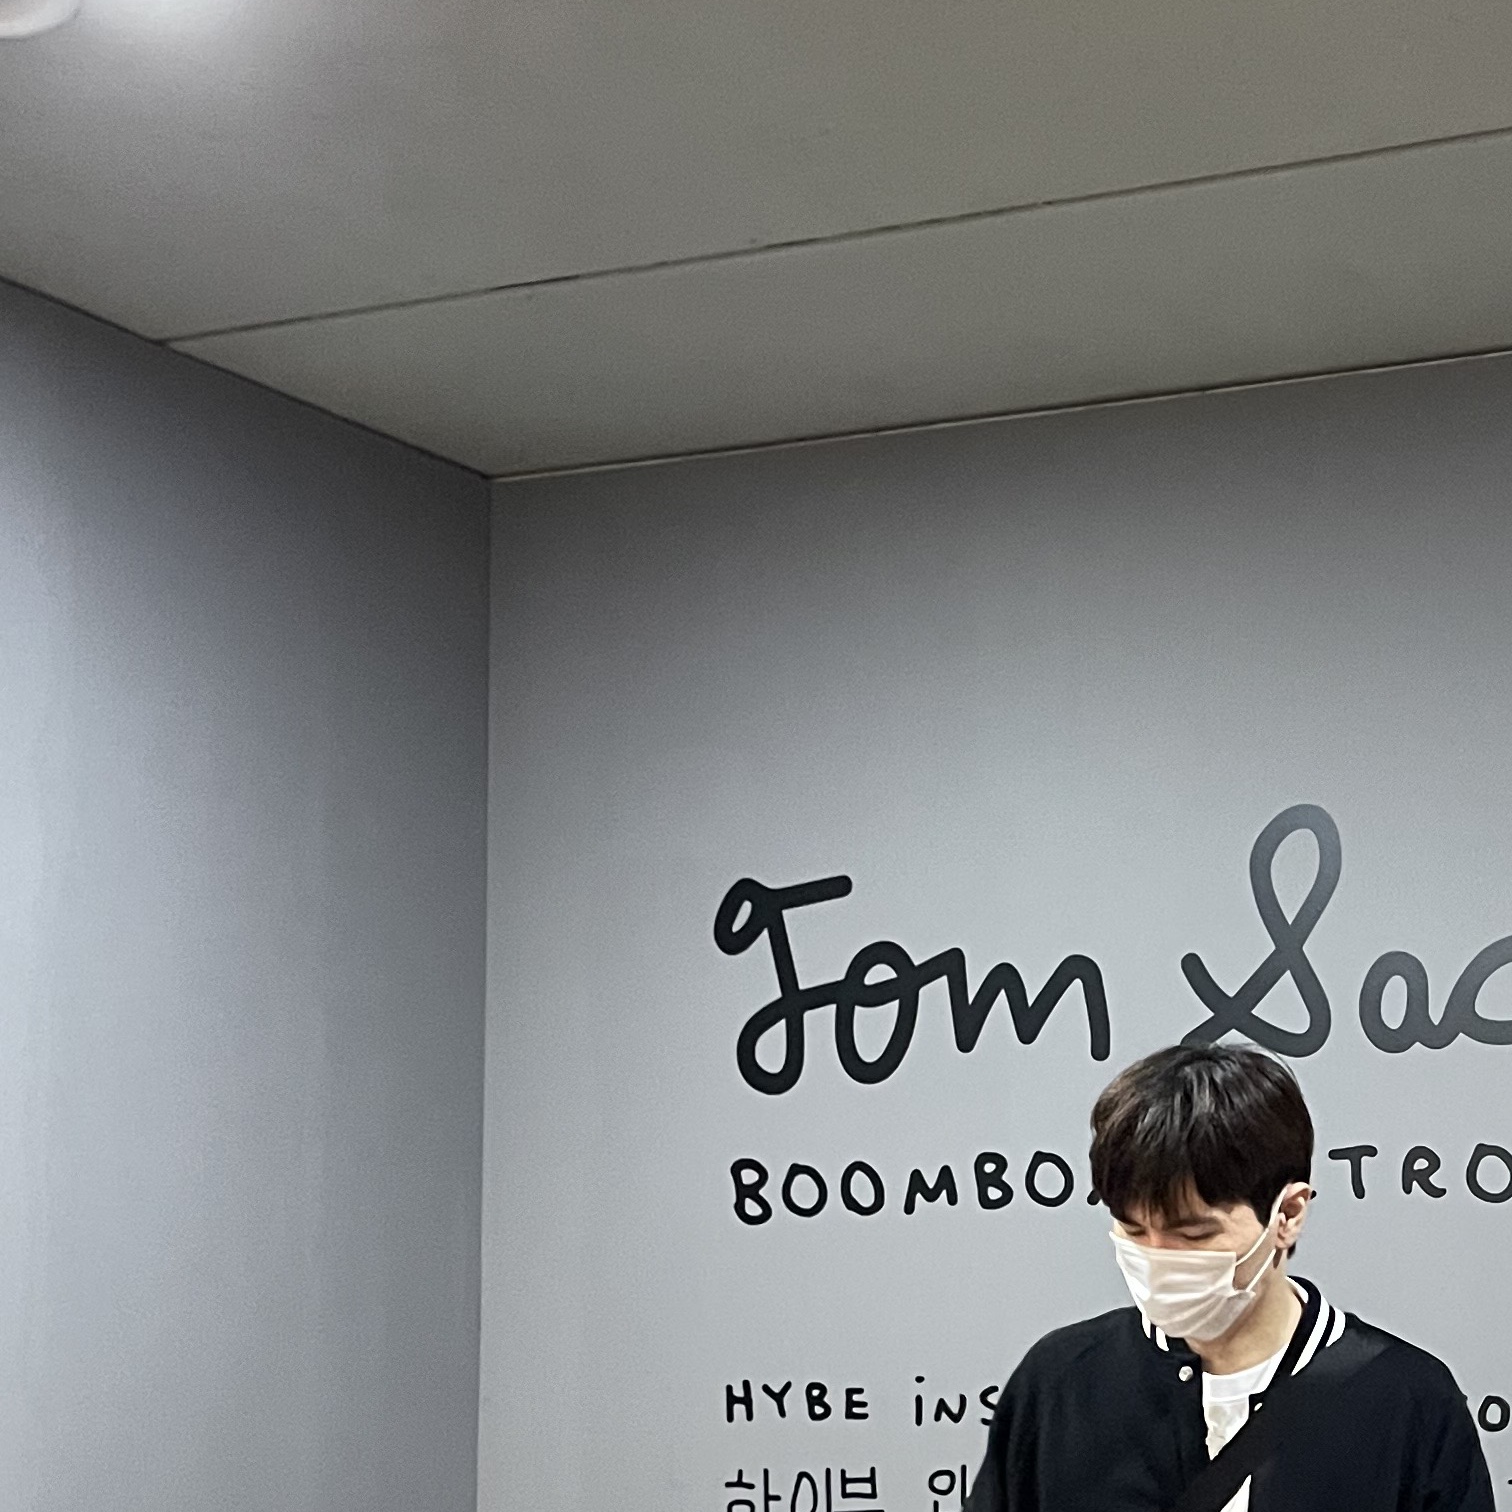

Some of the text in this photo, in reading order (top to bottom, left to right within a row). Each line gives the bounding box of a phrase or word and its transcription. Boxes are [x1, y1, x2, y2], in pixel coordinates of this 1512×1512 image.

[713, 875, 1110, 1095] Tom
[730, 1151, 1101, 1225] BOOMBO
[725, 1379, 870, 1423] HYBE
